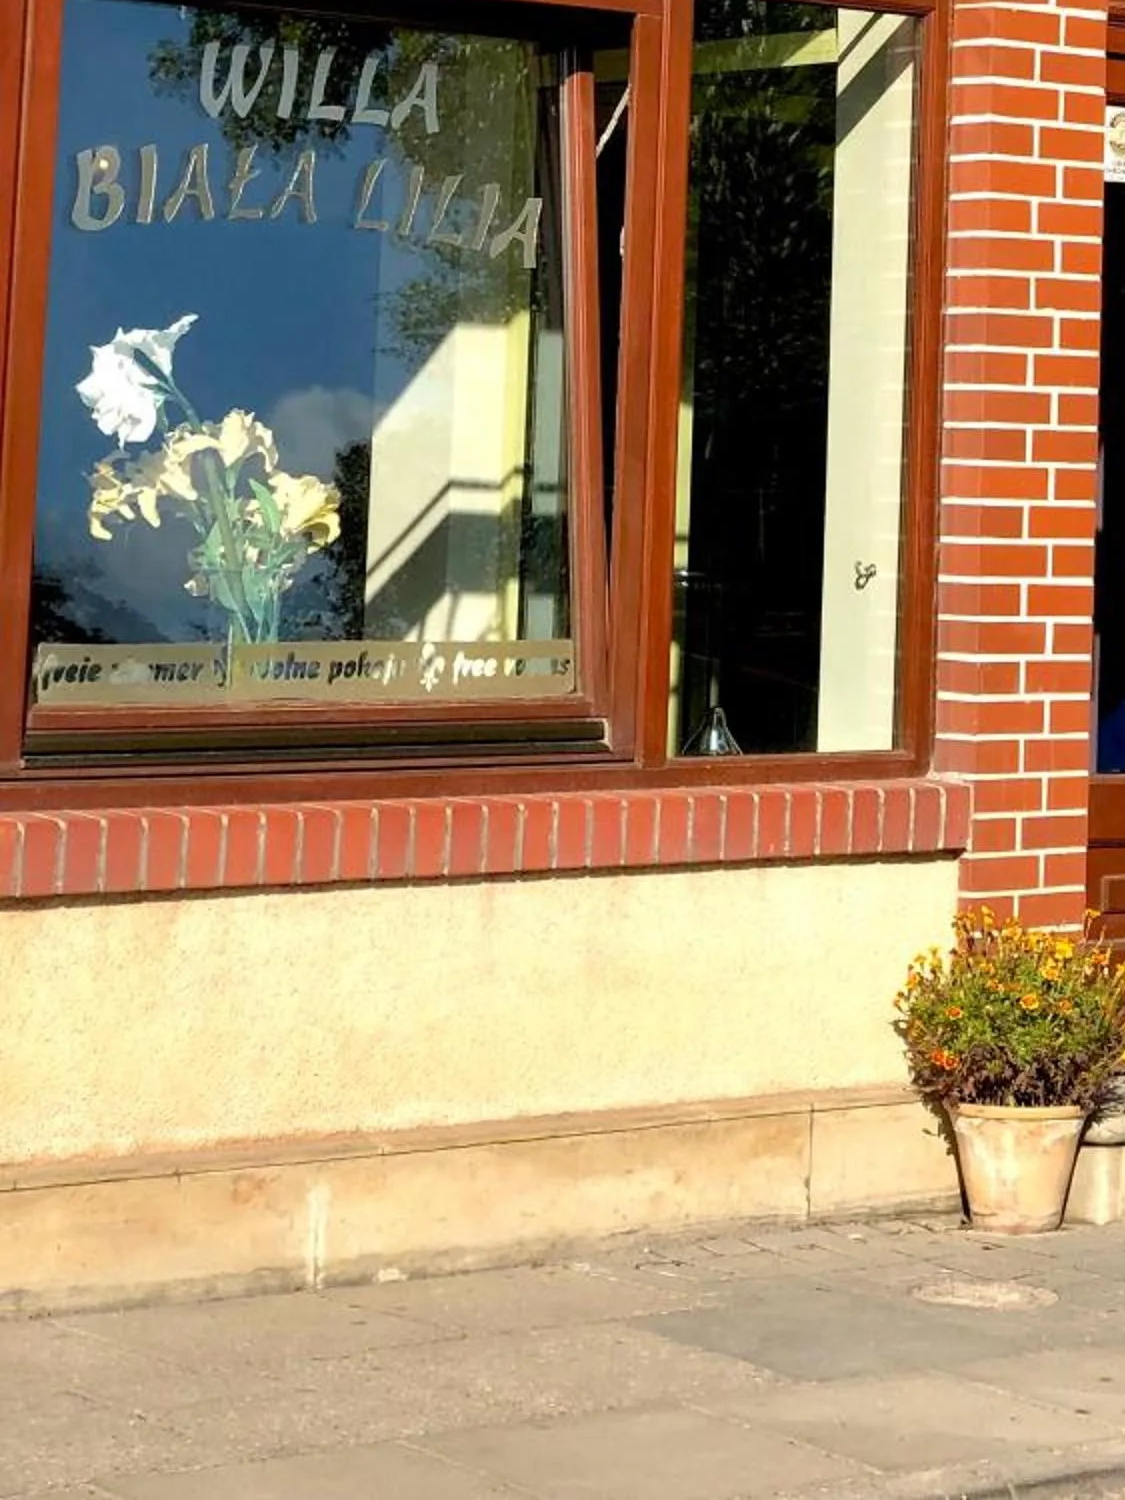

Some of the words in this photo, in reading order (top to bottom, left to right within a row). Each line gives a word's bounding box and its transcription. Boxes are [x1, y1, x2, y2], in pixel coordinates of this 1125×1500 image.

[200, 41, 440, 134] WILLA
[71, 143, 318, 232] BIAŁA
[354, 157, 544, 270] LILIA
[38, 653, 102, 690] freie
[452, 650, 498, 686] free
[503, 656, 571, 678] ros
